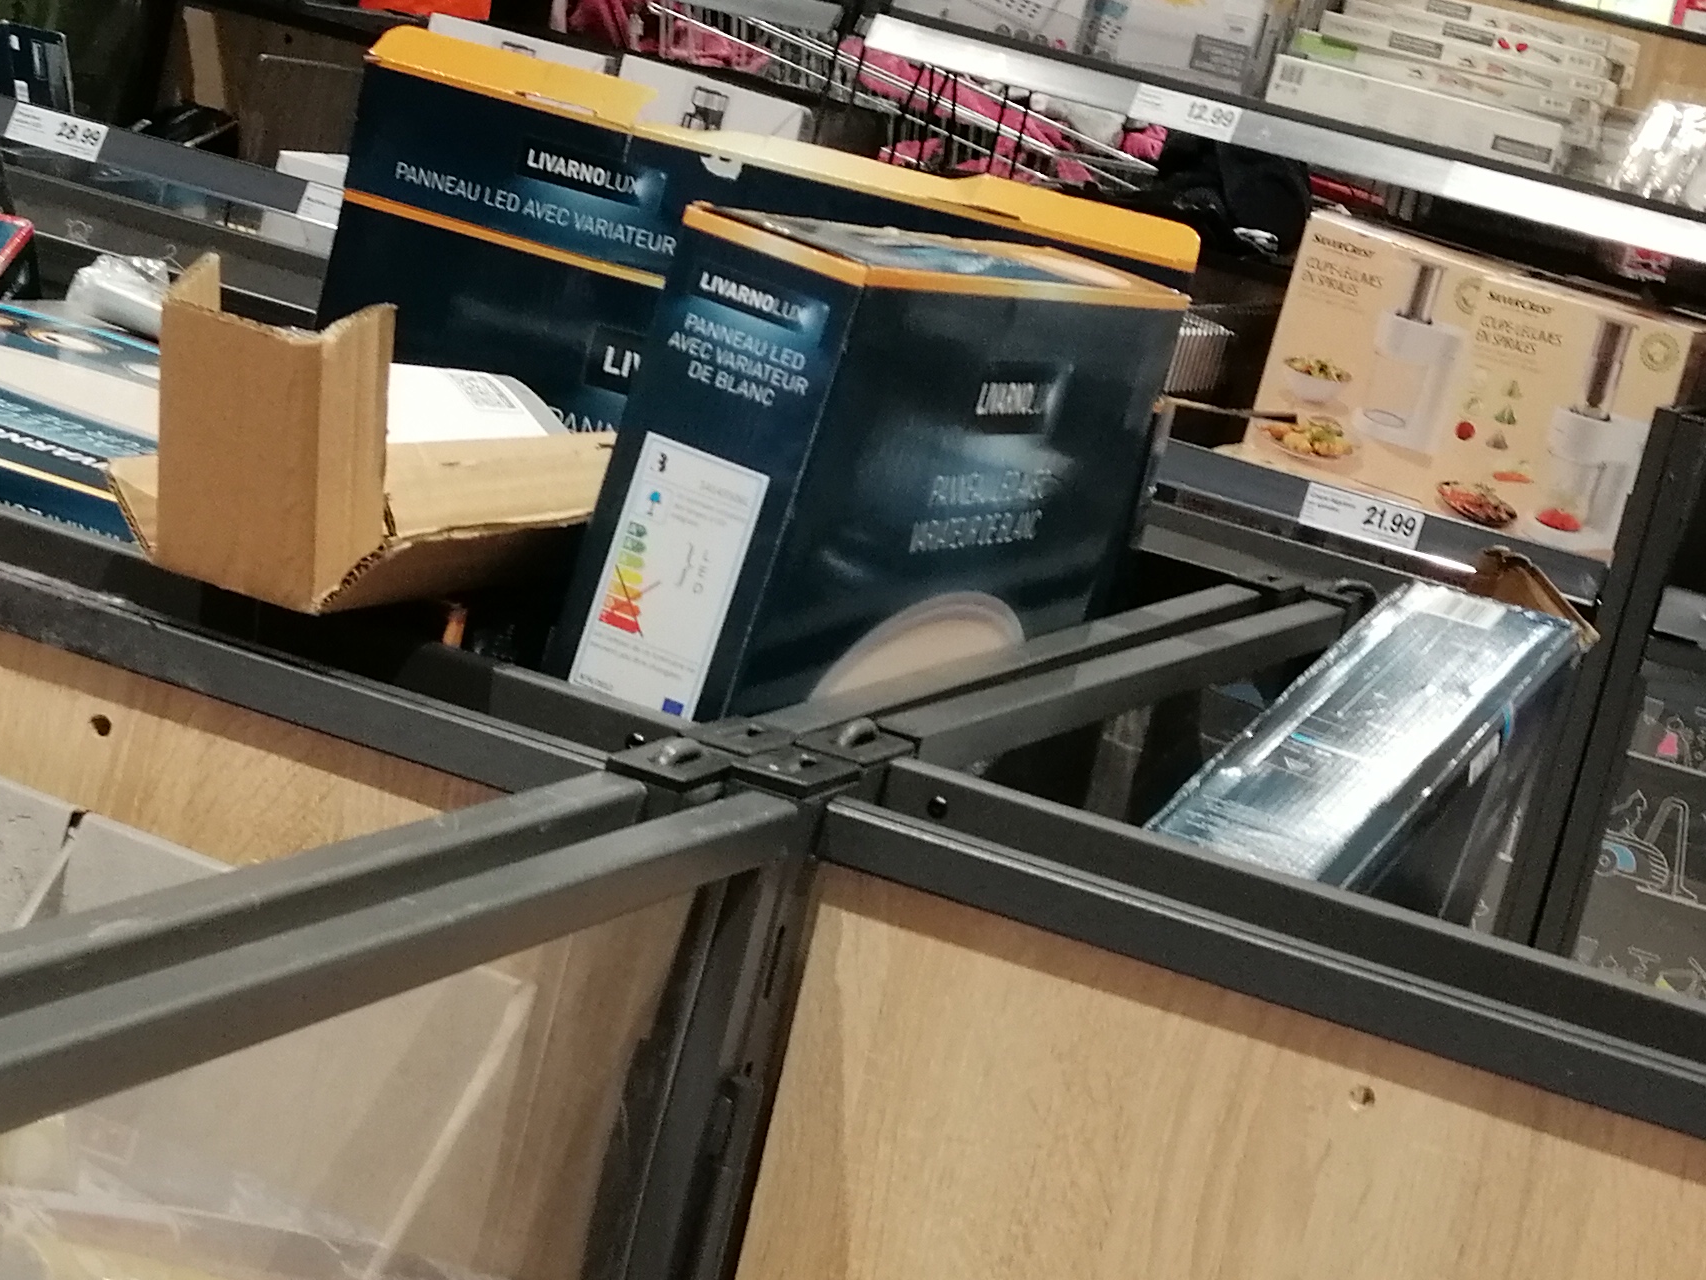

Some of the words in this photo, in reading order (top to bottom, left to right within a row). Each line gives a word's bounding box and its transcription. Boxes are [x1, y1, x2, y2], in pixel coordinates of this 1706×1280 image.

[55, 121, 101, 145] 28.99
[1186, 100, 1236, 127] 12.99
[395, 161, 481, 202] PANNEAU
[483, 185, 521, 213] LED
[523, 197, 571, 227] AVEC
[573, 211, 677, 256] VARIATEUR
[667, 331, 714, 362] AVEC
[714, 345, 809, 397] VARIATEUR
[684, 313, 769, 356] PANNEAU
[767, 342, 806, 371] LED
[687, 360, 712, 384] DE
[712, 373, 776, 408] BLANC
[1362, 505, 1416, 536] 21.99
